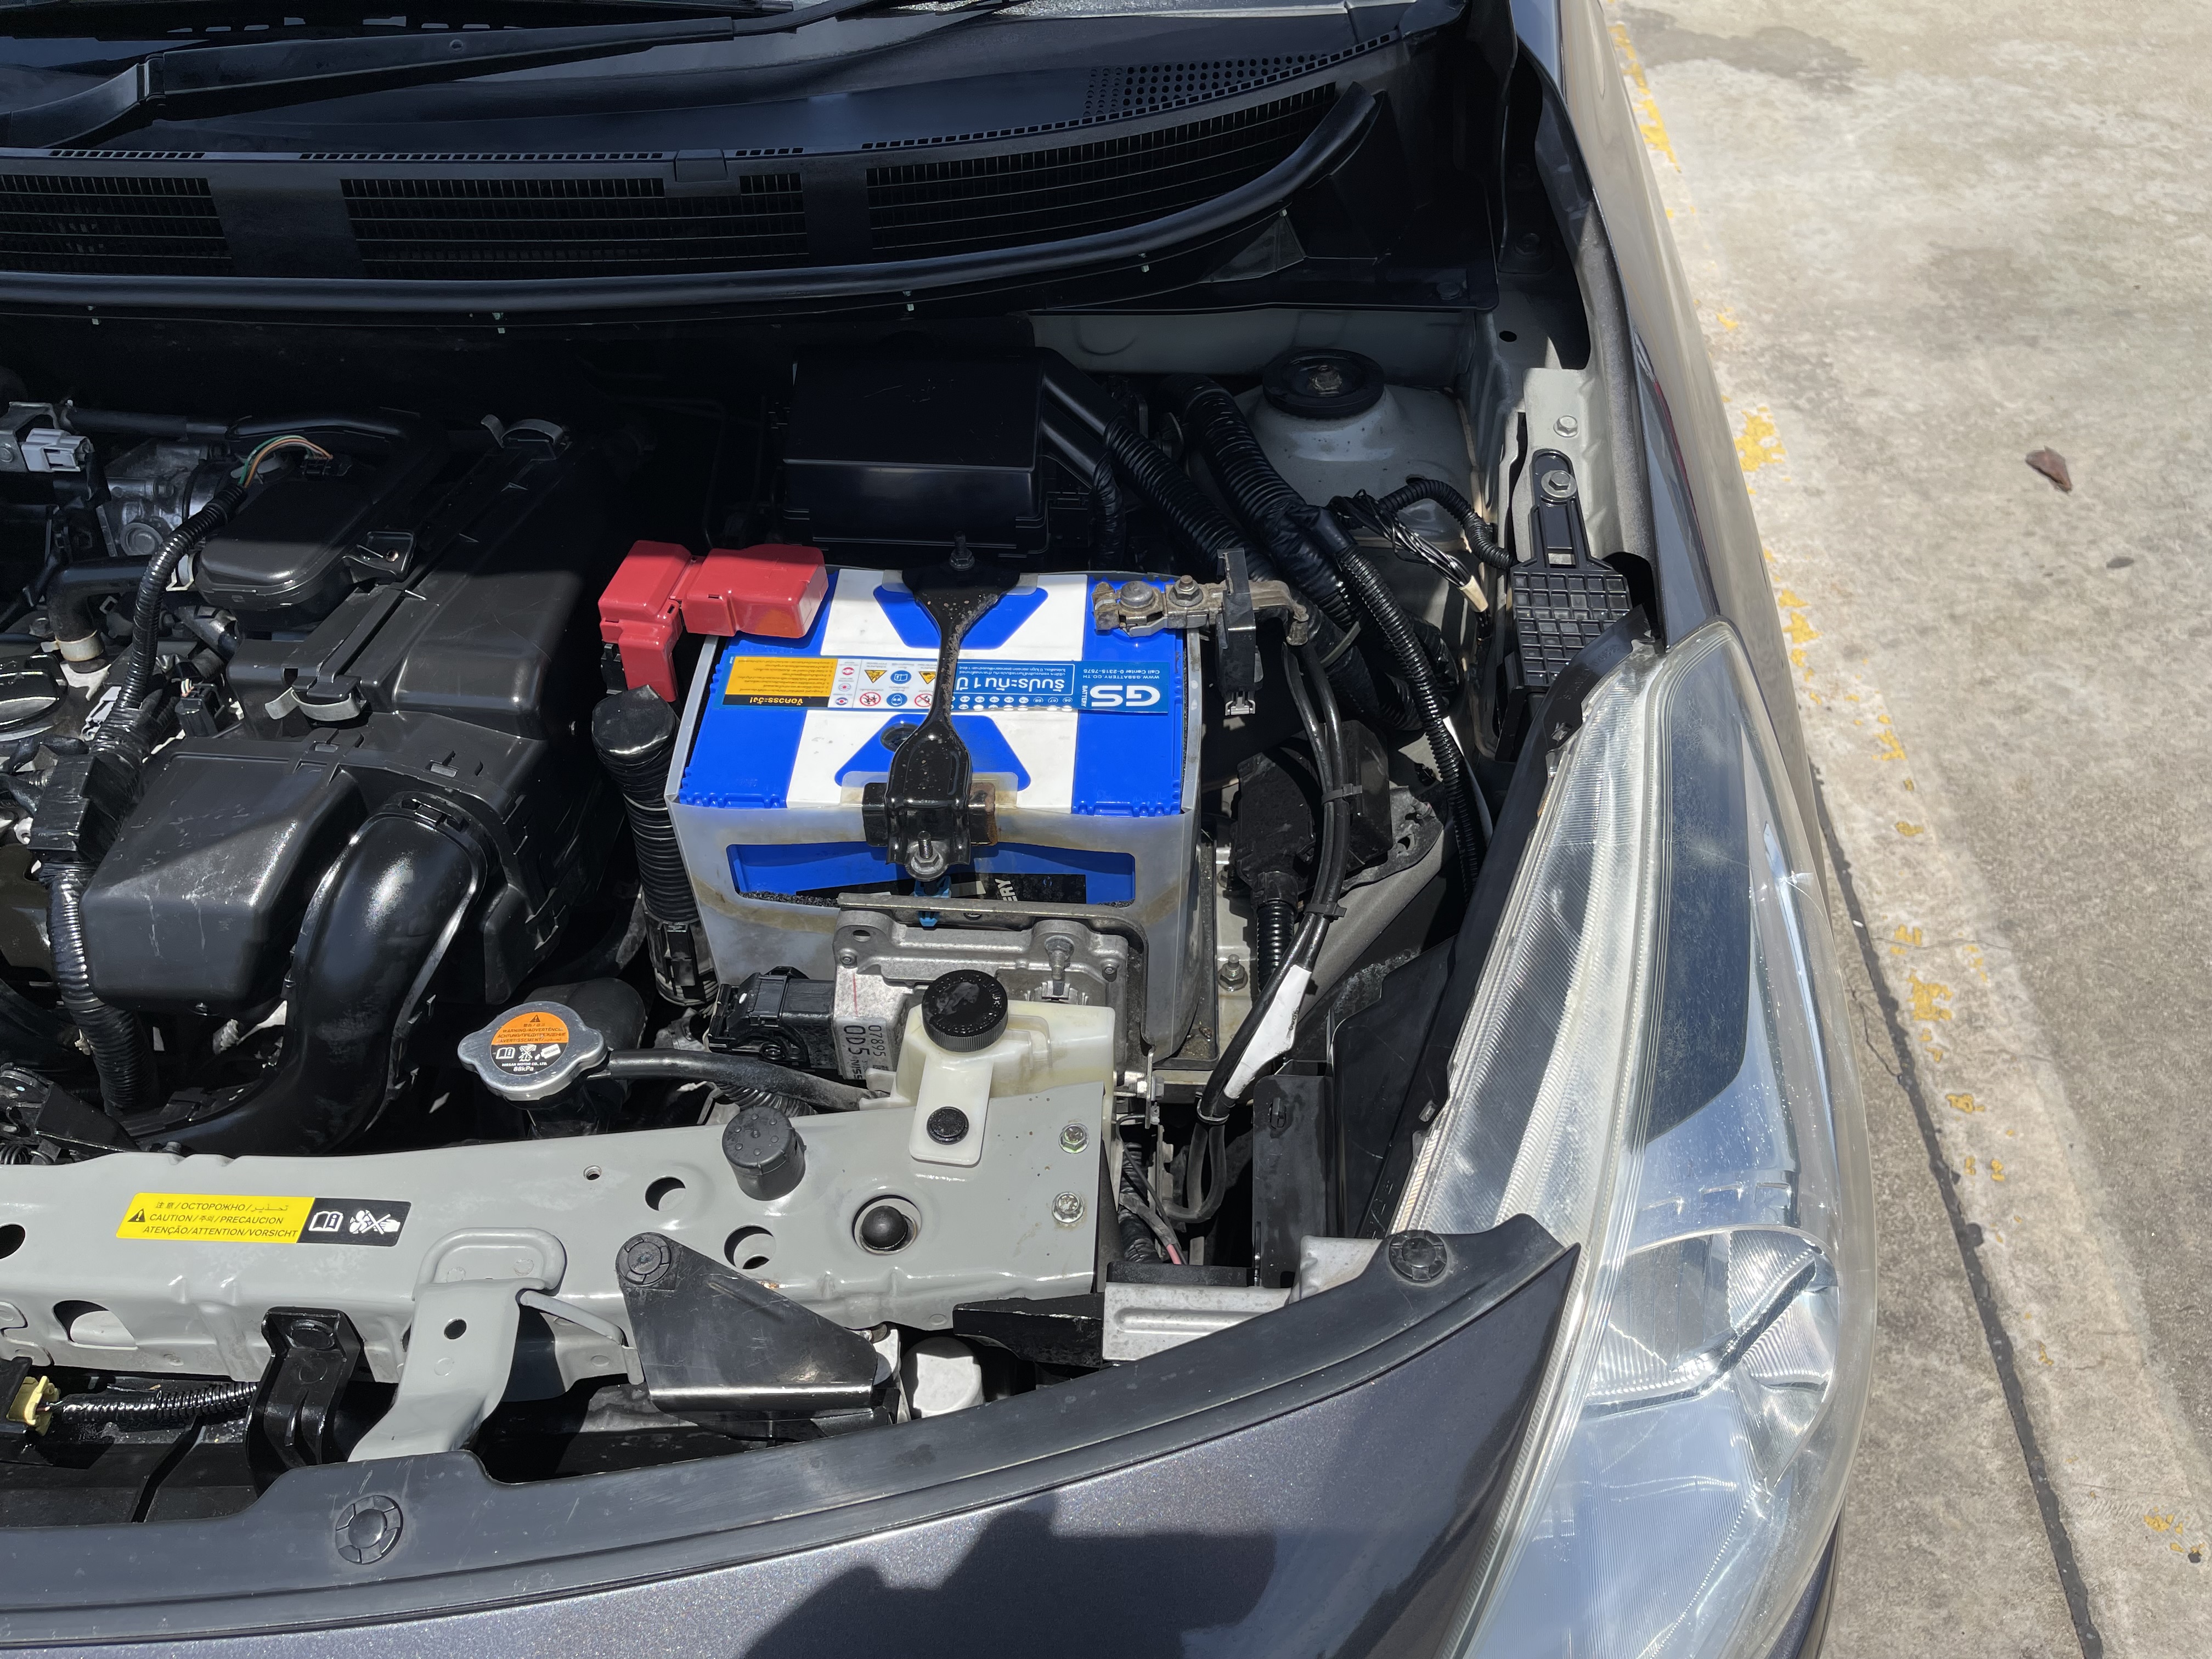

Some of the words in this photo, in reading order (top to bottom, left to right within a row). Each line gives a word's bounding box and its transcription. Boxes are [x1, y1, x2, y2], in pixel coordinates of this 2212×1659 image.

[956, 677, 969, 691] ปี
[974, 677, 981, 689] 1
[985, 677, 1065, 692] รับประกัน
[749, 696, 804, 706] ข้อควรระวัง!
[1090, 685, 1160, 707] GS
[868, 1025, 886, 1057] 07895
